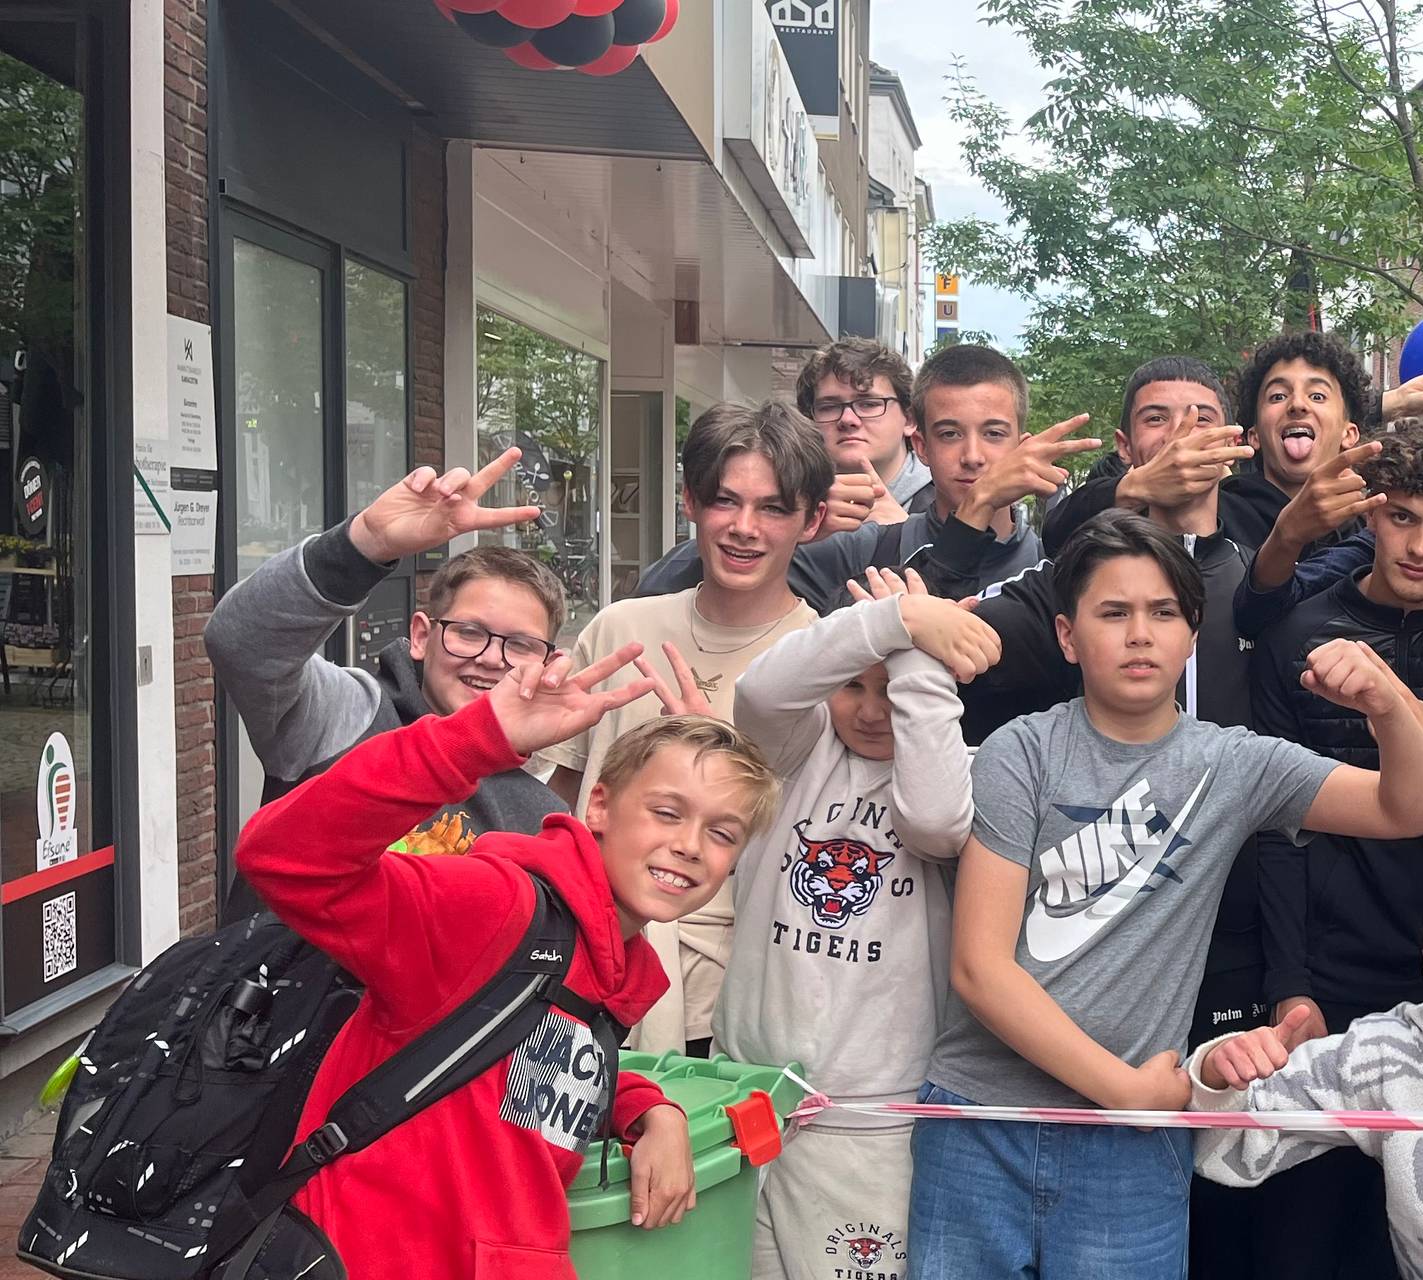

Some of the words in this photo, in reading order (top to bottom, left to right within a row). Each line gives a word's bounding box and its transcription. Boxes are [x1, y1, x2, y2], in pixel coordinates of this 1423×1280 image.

[780, 27, 834, 35] RESTAURANT
[1039, 778, 1161, 908] NIKE
[773, 920, 882, 963] TIGERS
[1212, 1008, 1243, 1025] Palm
[512, 1076, 601, 1141] JONE
[825, 1223, 907, 1260] ORIGINALS
[834, 1268, 898, 1280] TIGERS
